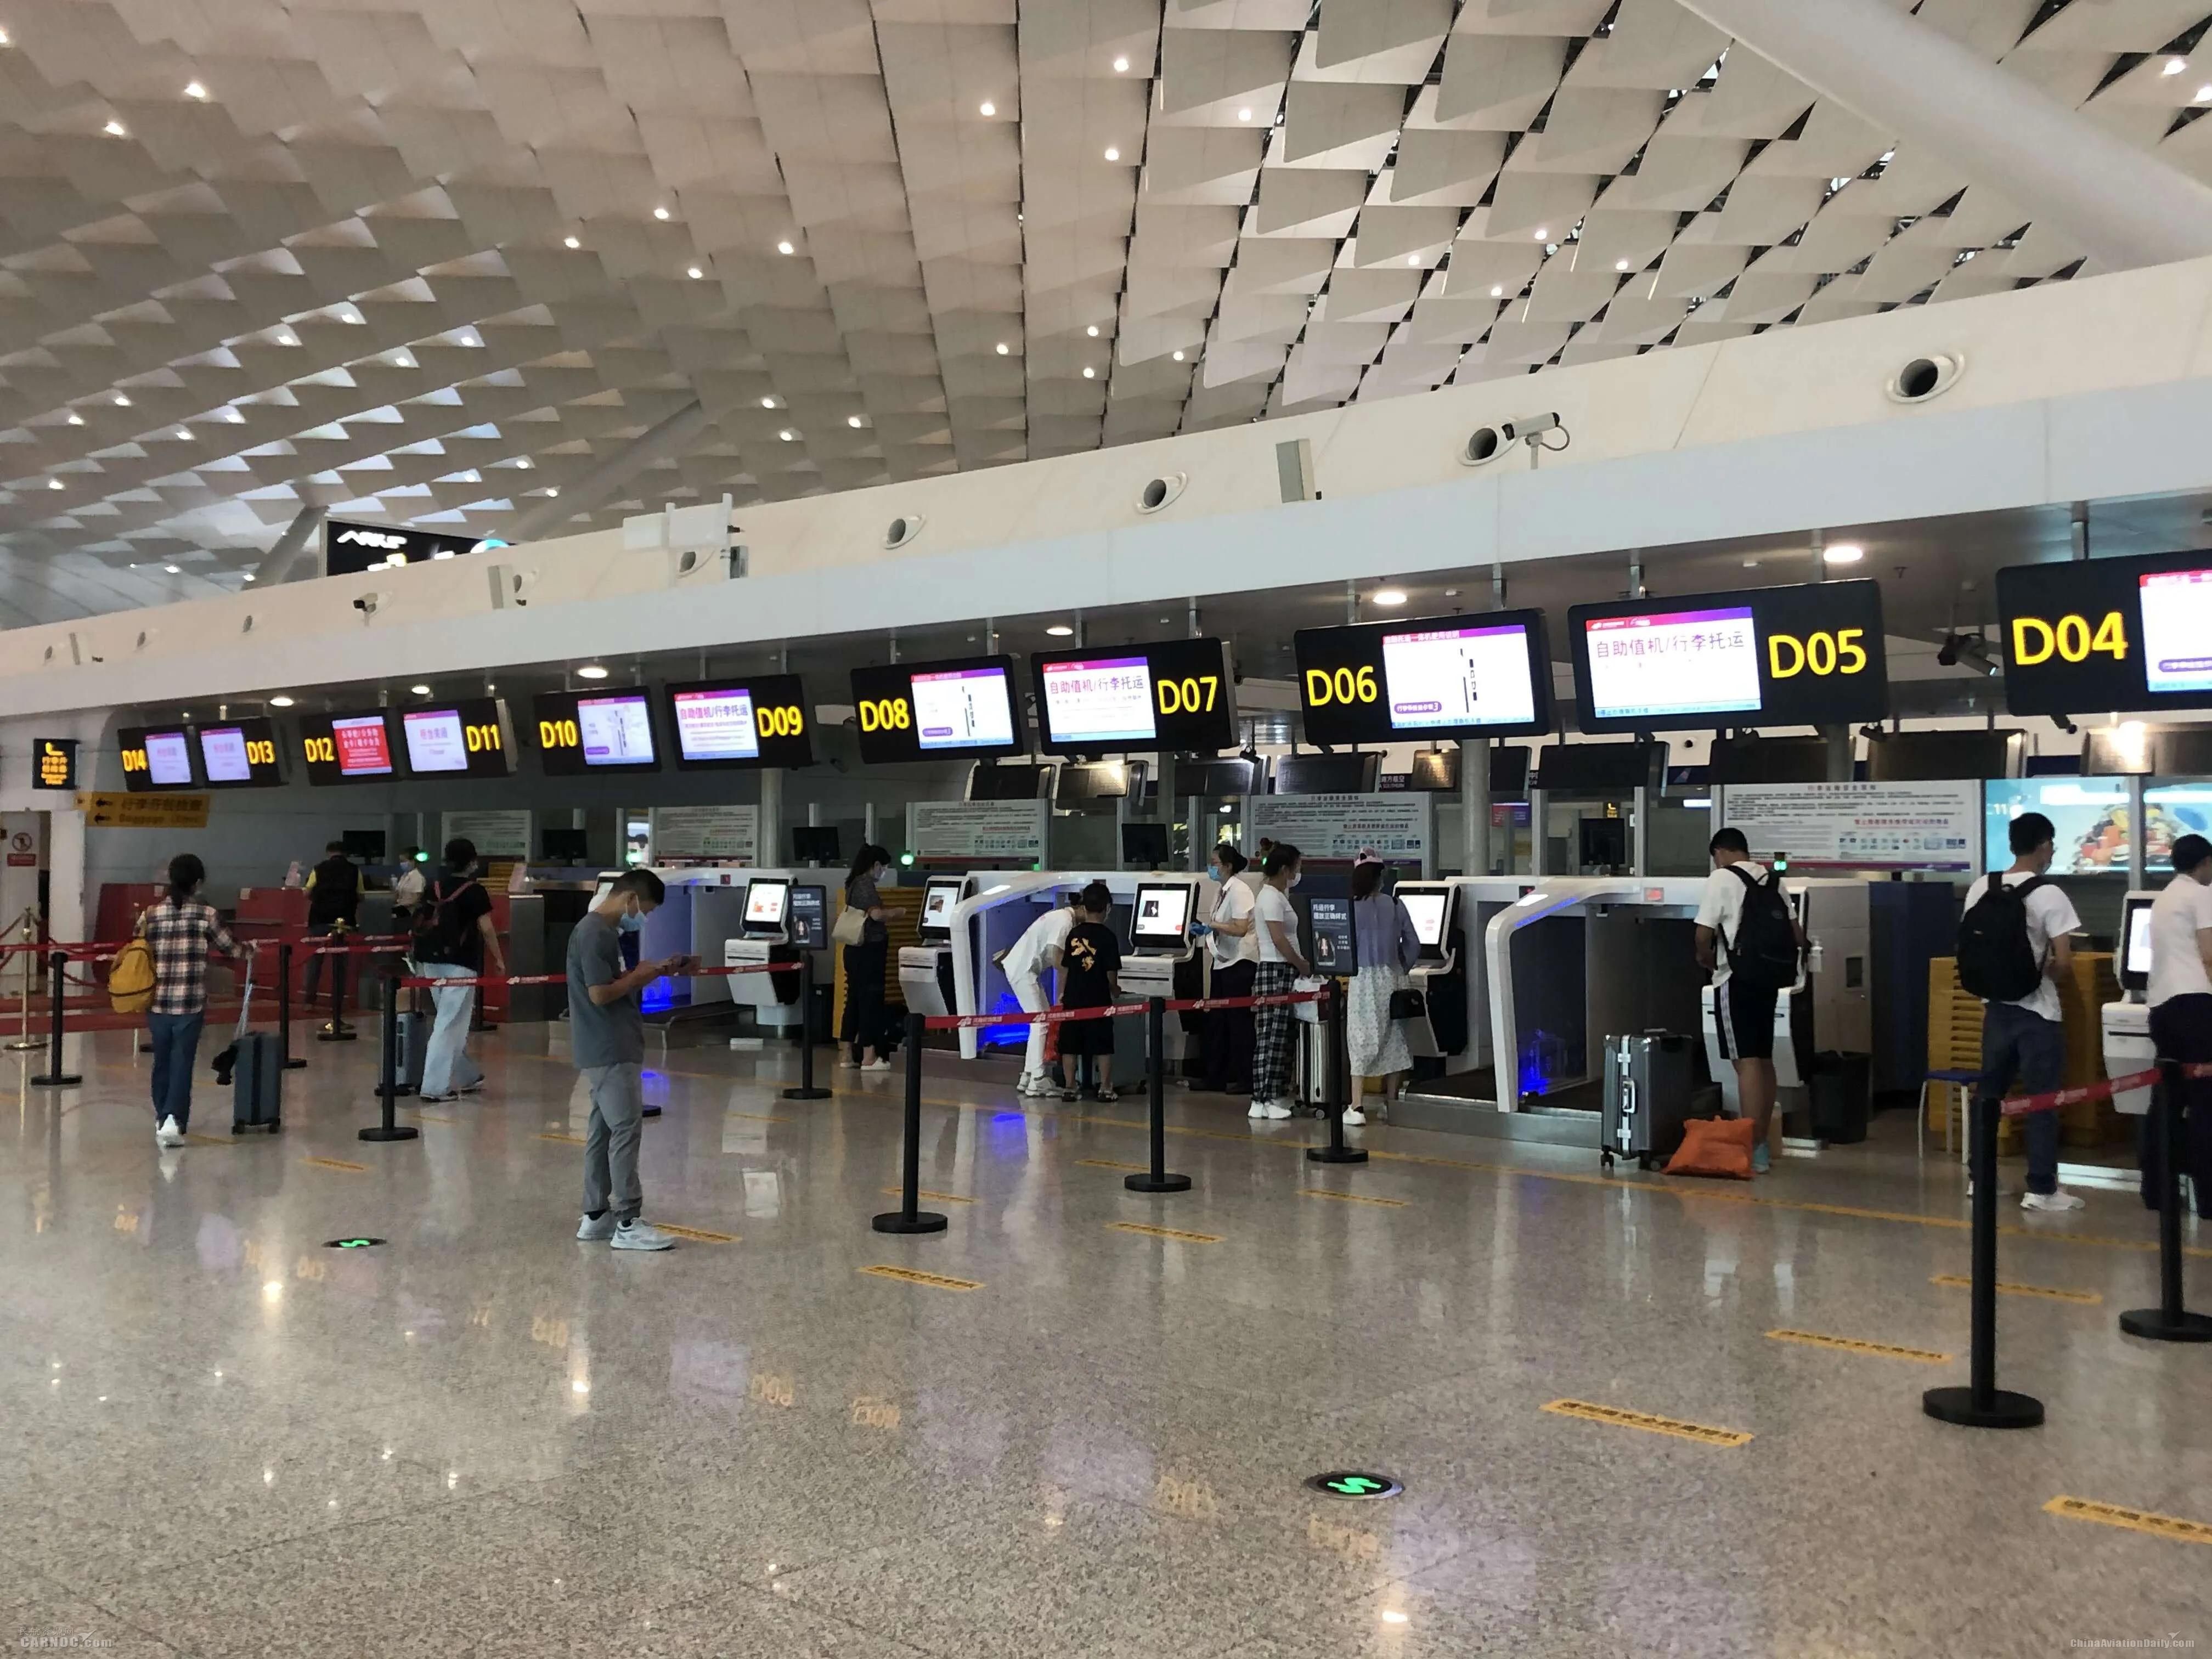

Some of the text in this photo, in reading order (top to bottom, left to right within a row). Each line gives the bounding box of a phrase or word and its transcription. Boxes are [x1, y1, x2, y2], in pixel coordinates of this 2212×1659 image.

[1596, 631, 1745, 658] 自助值机/行李托运
[2012, 611, 2129, 665] D04
[1768, 629, 1867, 679] D05
[1049, 675, 1144, 695] 自助值机/行李托运
[1157, 676, 1217, 714] D07
[1306, 665, 1378, 707] D06
[757, 706, 803, 737] D09
[859, 698, 910, 732] D08
[465, 724, 500, 752] D11
[539, 719, 578, 748] D10
[121, 749, 147, 772] D14
[246, 741, 275, 765] D13
[304, 737, 335, 763] D12
